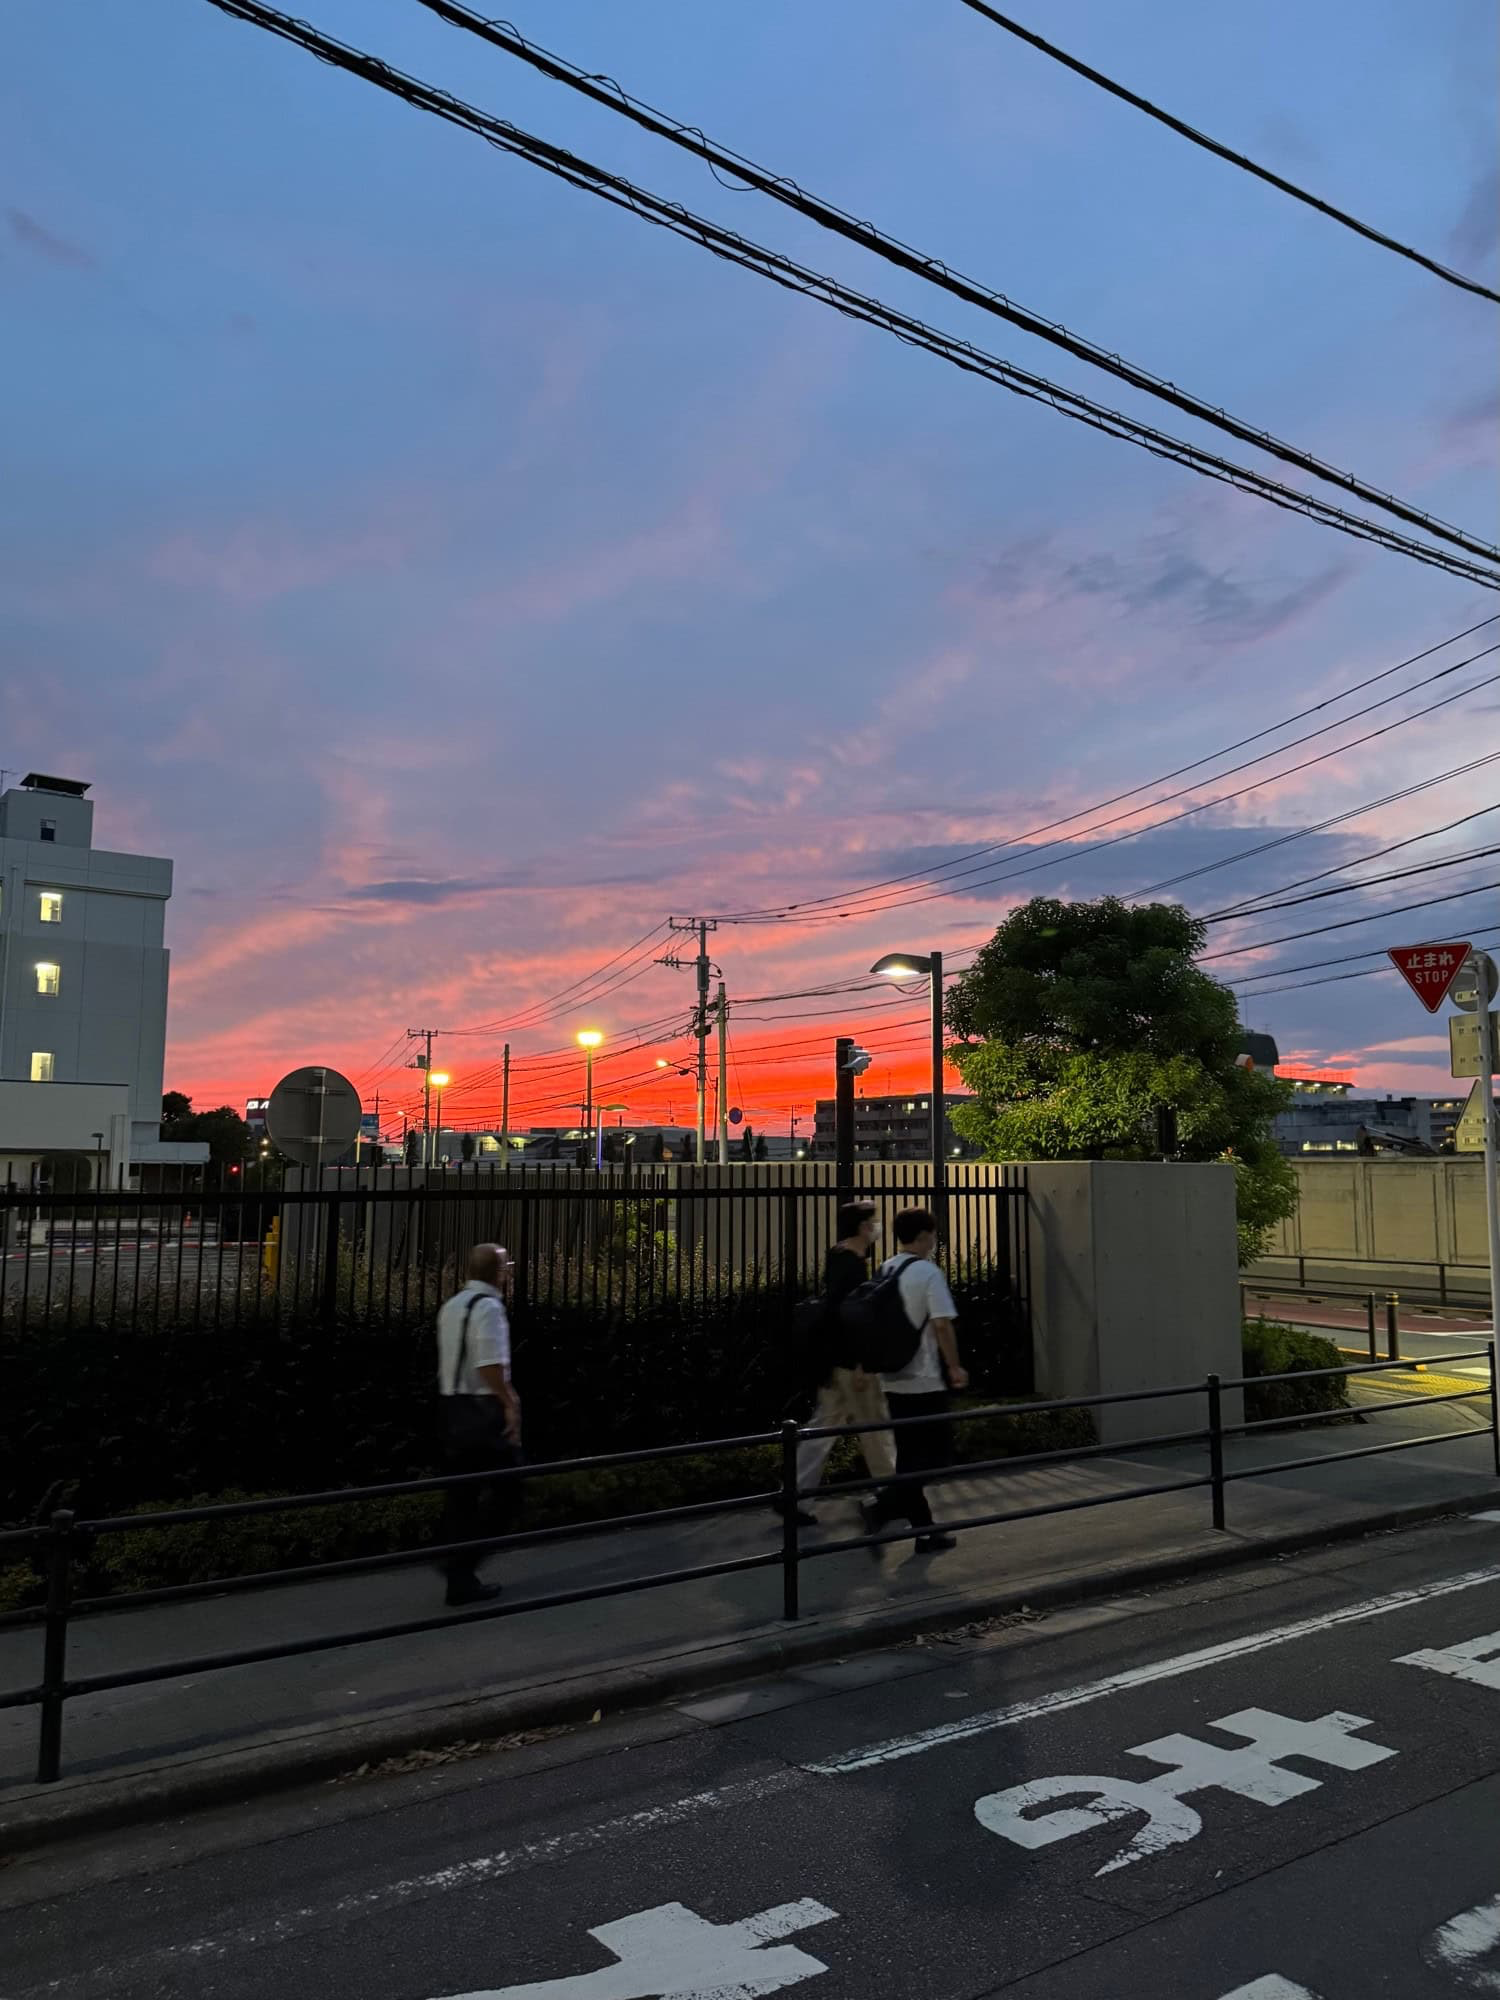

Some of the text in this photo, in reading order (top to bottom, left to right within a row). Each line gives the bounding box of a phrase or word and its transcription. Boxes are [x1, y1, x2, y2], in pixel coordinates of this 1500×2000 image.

[1406, 951, 1455, 969] 止まれ
[1415, 970, 1449, 984] STOP
